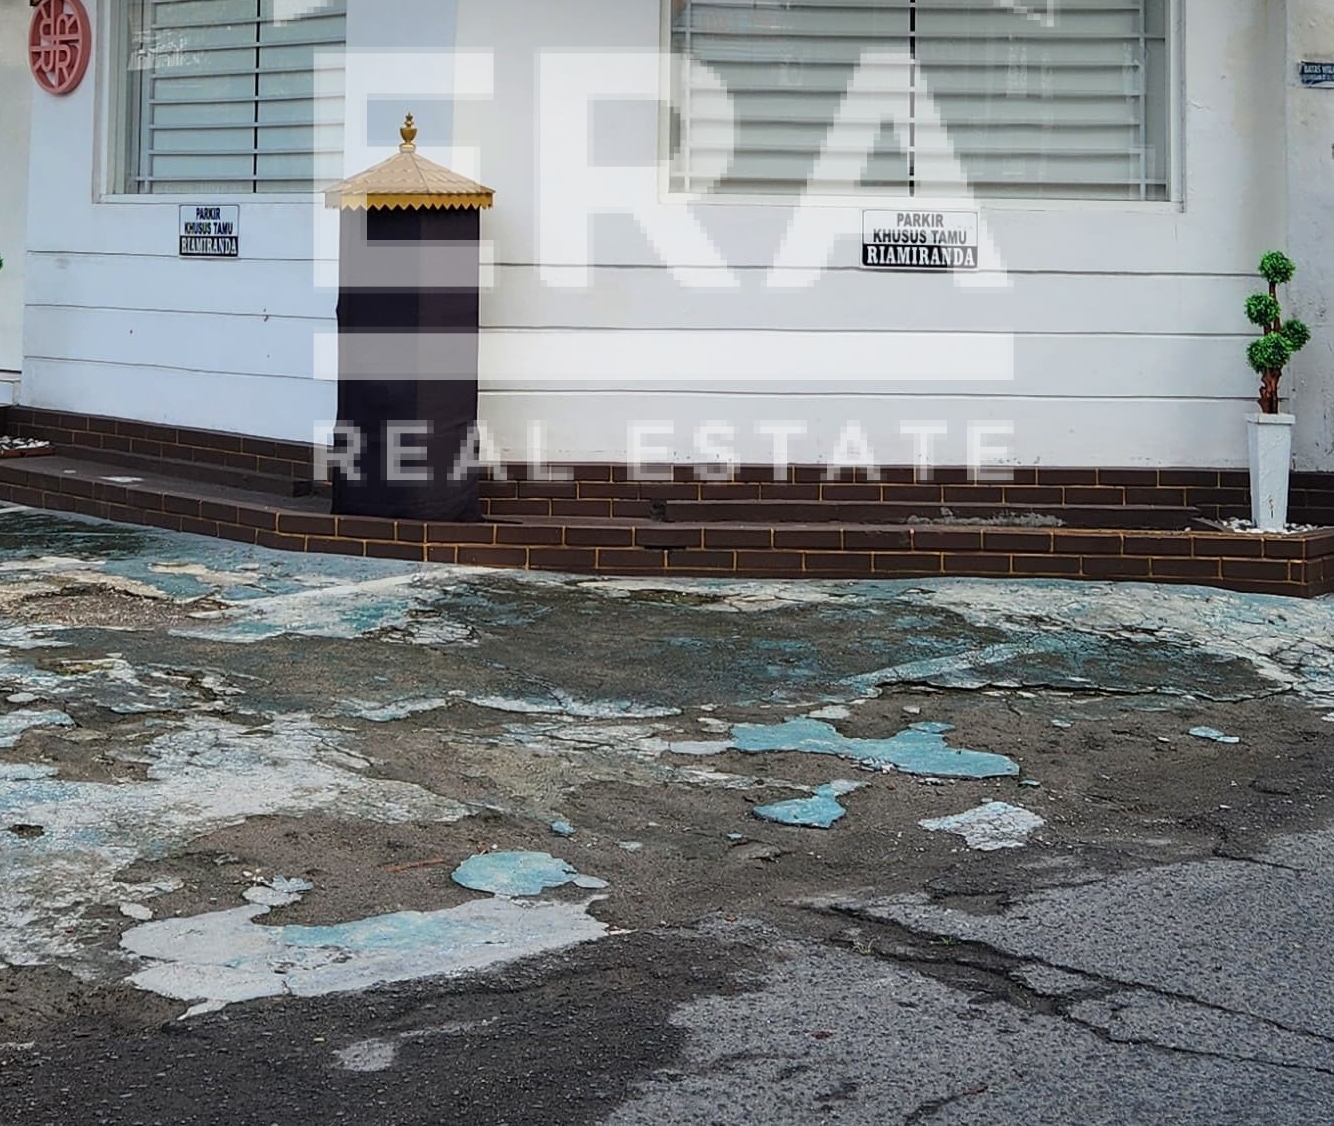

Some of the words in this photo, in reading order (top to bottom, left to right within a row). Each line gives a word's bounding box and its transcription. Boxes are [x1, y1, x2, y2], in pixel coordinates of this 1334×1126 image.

[195, 207, 221, 220] PARKIR
[896, 212, 944, 228] PARKIR
[184, 222, 212, 235] KHUSUS
[213, 222, 234, 235] TAMU
[873, 228, 927, 244] KHUSUS
[931, 229, 967, 245] TAMU
[867, 245, 975, 266] RIAMIRANDA
